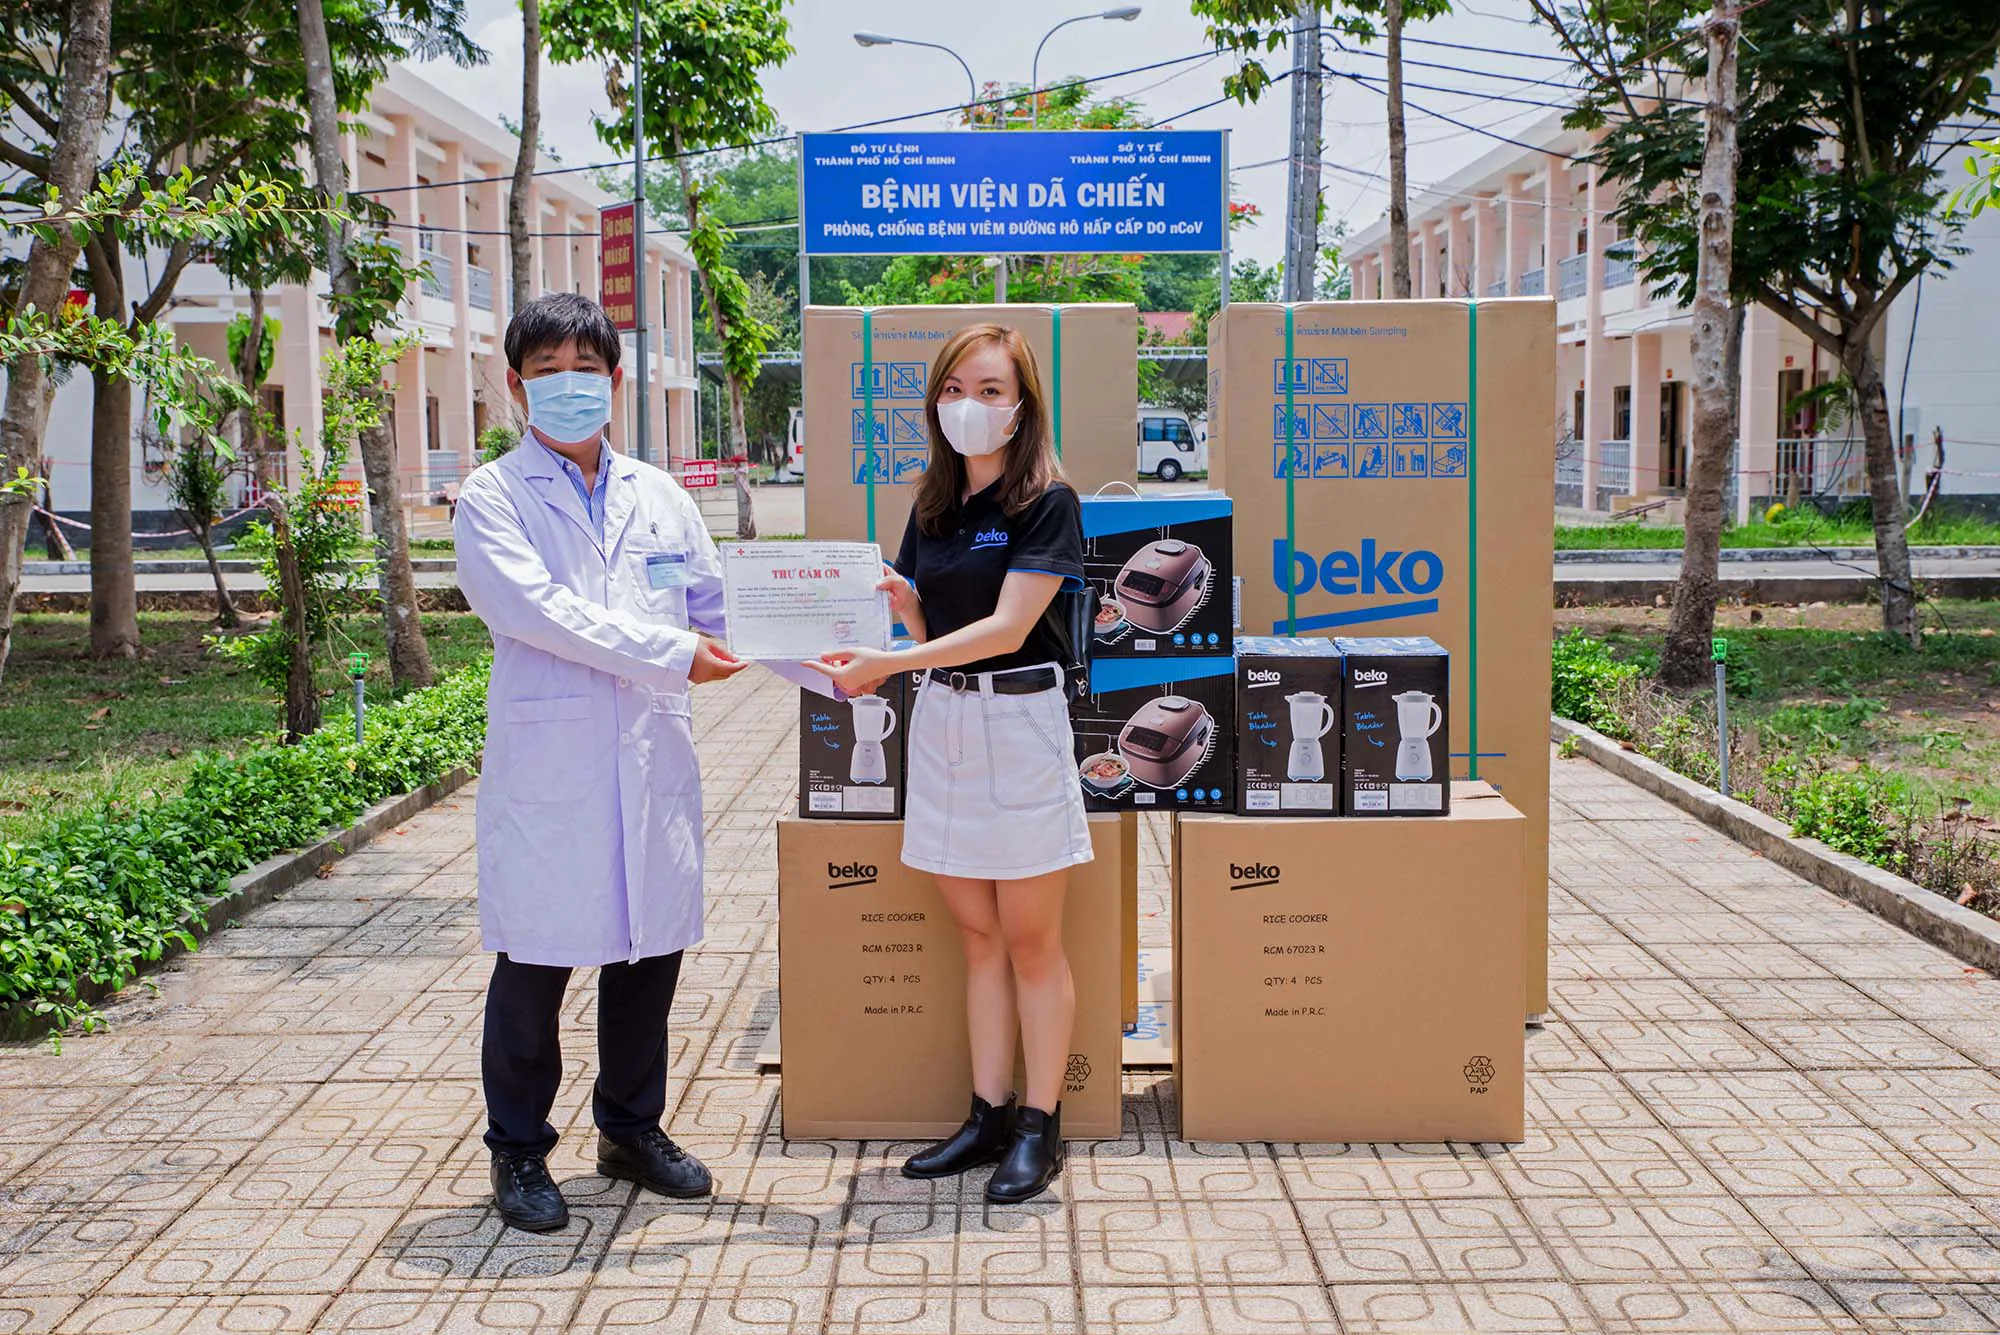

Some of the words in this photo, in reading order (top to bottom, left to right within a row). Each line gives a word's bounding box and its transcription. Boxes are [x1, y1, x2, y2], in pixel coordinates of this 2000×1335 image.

[851, 143, 866, 154] BỘ
[870, 144, 887, 154] TƯ
[889, 142, 920, 154] LỆNH
[1136, 144, 1144, 152] Y
[1147, 141, 1164, 152] TẾ
[815, 155, 853, 166] THÀNH
[857, 154, 881, 166] PHỐ
[903, 155, 923, 165] CHÍ
[926, 156, 956, 165] MINH
[1070, 153, 1109, 164] THÀNH
[1112, 152, 1136, 164] PHỐ
[1159, 154, 1178, 164] CHÍ
[1181, 155, 1211, 164] MINH
[861, 178, 941, 214] BỆNH
[950, 177, 1018, 213] VIỆN
[1028, 177, 1067, 208] DÃ
[1076, 173, 1165, 208] CHIẾN
[823, 220, 874, 238] PHÒNG,
[878, 218, 924, 236] CHỐNG
[928, 220, 966, 238] BỆNH
[970, 220, 1005, 236] VIÊM
[1009, 219, 1056, 235] ĐƯỜNG
[1060, 219, 1079, 235] HÔ
[1083, 217, 1112, 235] HẤP
[1115, 217, 1143, 234] CẤP
[1147, 221, 1166, 234] DO
[1170, 221, 1203, 234] nCoV
[1273, 538, 1444, 596] beko
[772, 568, 796, 580] THƯ
[799, 567, 822, 580] CẢM
[825, 567, 840, 579] ƠN
[1247, 669, 1281, 683] beko
[1354, 669, 1388, 683] beko
[809, 713, 832, 722] Table
[1247, 711, 1268, 720] Table
[1354, 711, 1376, 720] Table
[1249, 721, 1277, 730] Blender
[1355, 721, 1385, 731] Blender
[828, 862, 878, 878] beko
[1230, 863, 1280, 880] beko
[861, 913, 883, 923] RICE
[887, 913, 926, 922] COOKER
[1263, 914, 1286, 924] RICE
[1289, 914, 1328, 923] COOKER
[862, 944, 883, 953] RCM
[885, 944, 913, 953] 67023
[916, 944, 923, 952] R
[1263, 946, 1284, 955] RCM
[1287, 945, 1316, 955] 67023
[1318, 945, 1325, 954] R
[863, 975, 887, 985] QTY:
[889, 975, 895, 984] 4
[903, 975, 920, 984] PCS
[1264, 976, 1288, 987] QTY:
[1290, 976, 1297, 985] 4
[1304, 976, 1322, 985] PCS
[864, 1005, 888, 1015] Made
[890, 1006, 899, 1014] in
[1265, 1007, 1289, 1016] Made
[1291, 1007, 1300, 1016] in
[1301, 1007, 1326, 1016] P.R.C.
[1066, 1084, 1085, 1092] PAP
[1470, 1087, 1488, 1095] PAP
